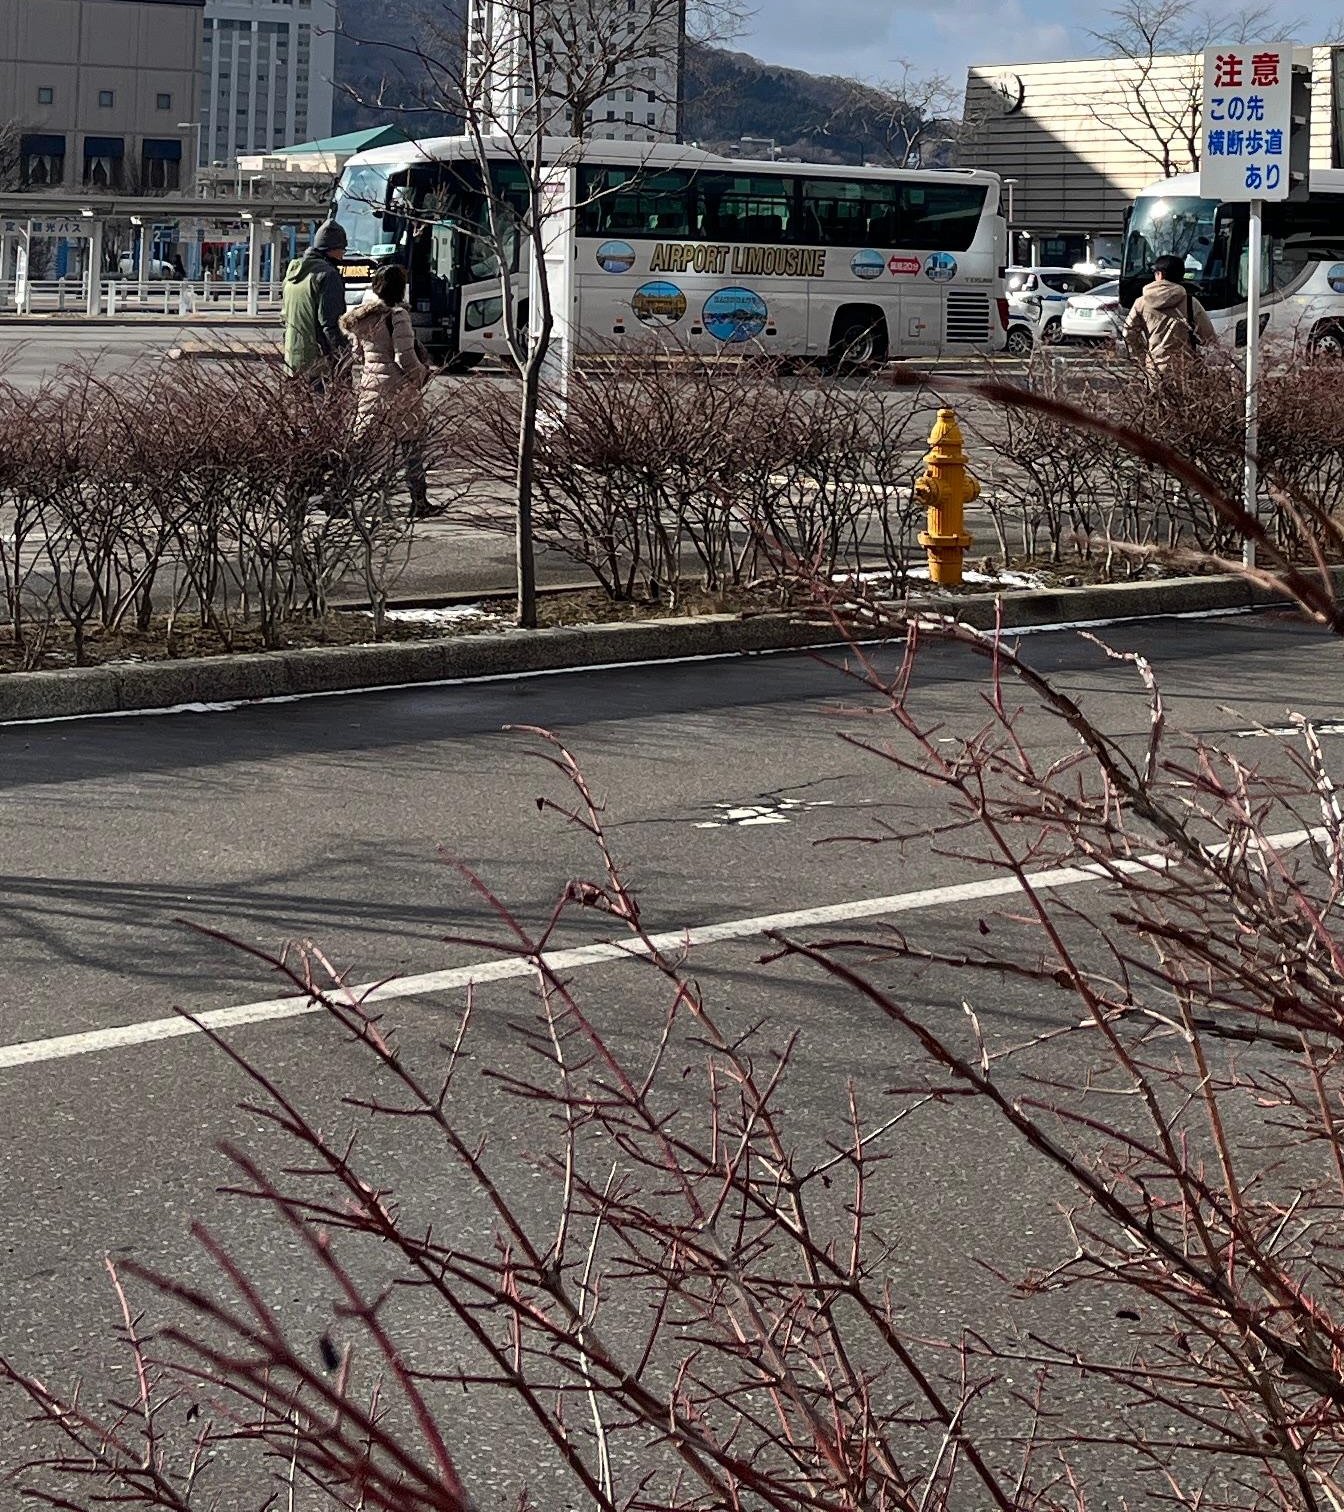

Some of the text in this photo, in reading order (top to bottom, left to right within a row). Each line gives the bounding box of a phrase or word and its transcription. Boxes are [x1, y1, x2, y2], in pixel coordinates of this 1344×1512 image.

[1214, 53, 1280, 88] 注意
[1210, 95, 1264, 122] この先
[1208, 129, 1283, 156] 横断歩道
[1245, 163, 1280, 190] あり
[650, 243, 826, 277] AIRPORT LIMOUSINE
